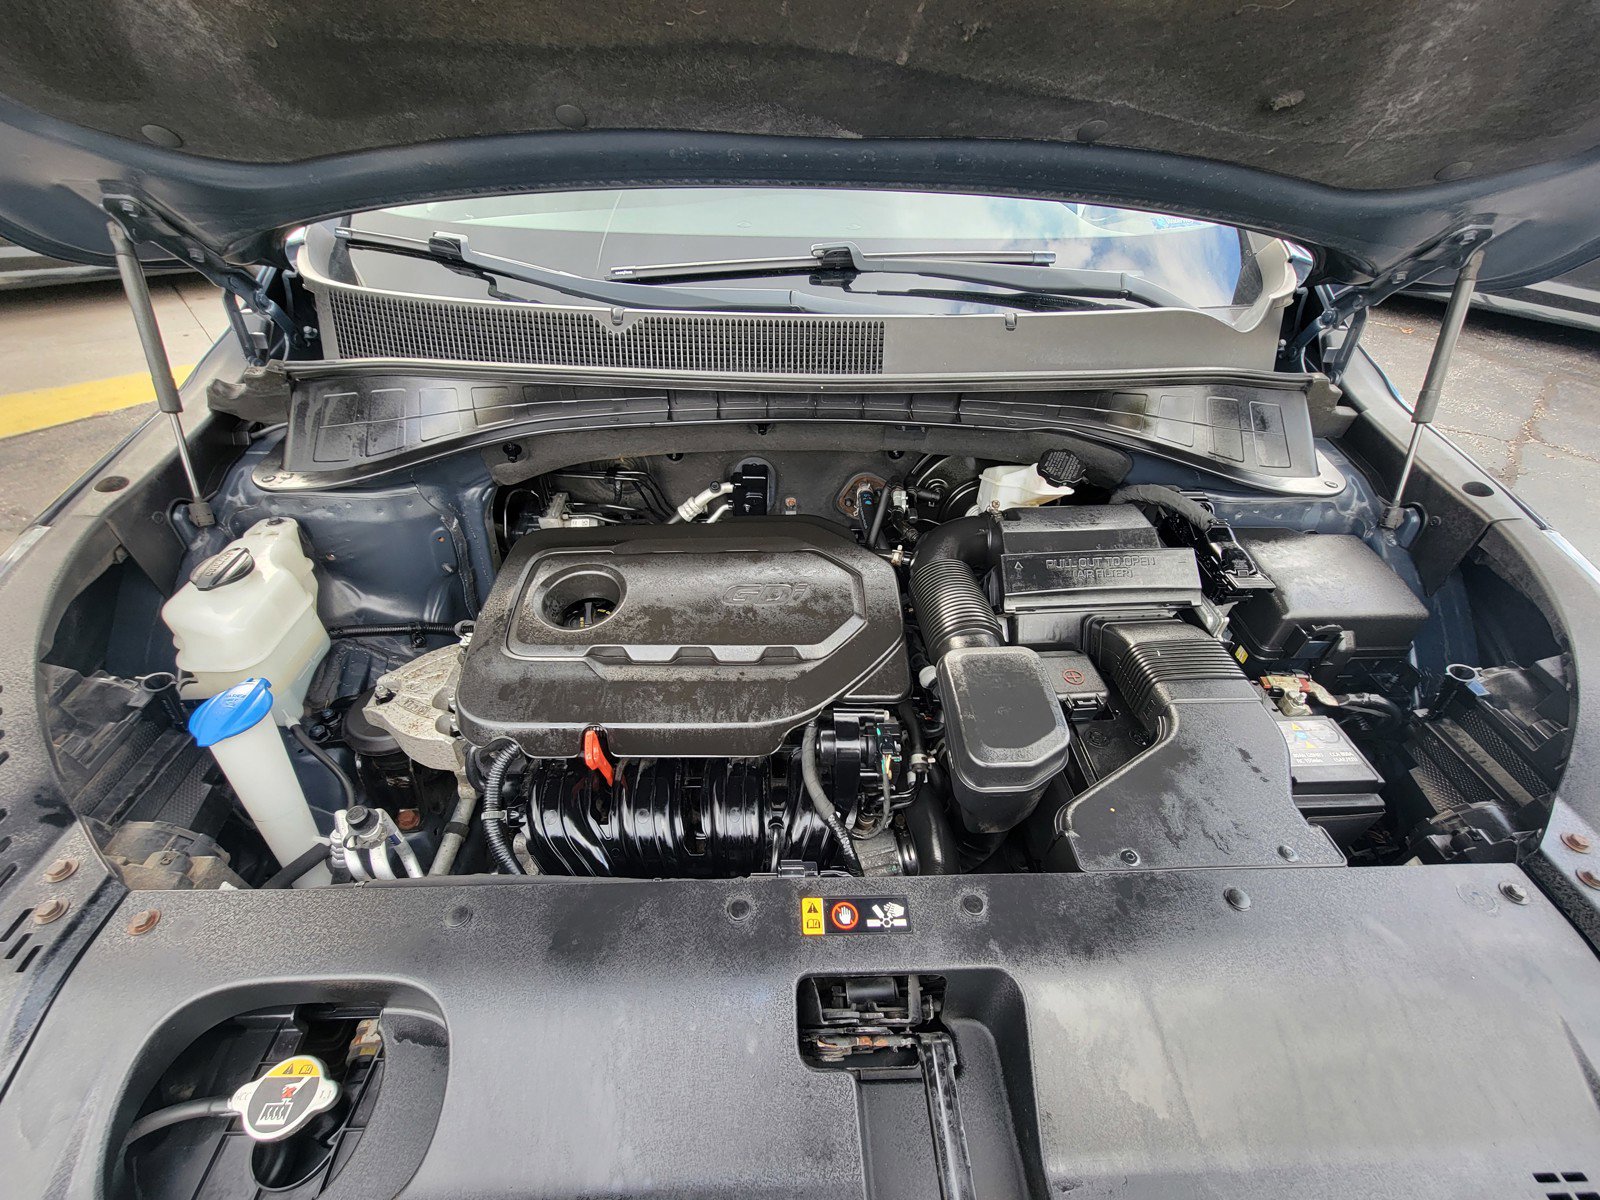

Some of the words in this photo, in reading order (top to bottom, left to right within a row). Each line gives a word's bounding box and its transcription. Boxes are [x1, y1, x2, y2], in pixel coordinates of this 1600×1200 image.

[1045, 559, 1077, 569] PULL
[1078, 557, 1102, 568] OUT
[1104, 556, 1121, 566] TO
[1122, 555, 1156, 566] OPEN
